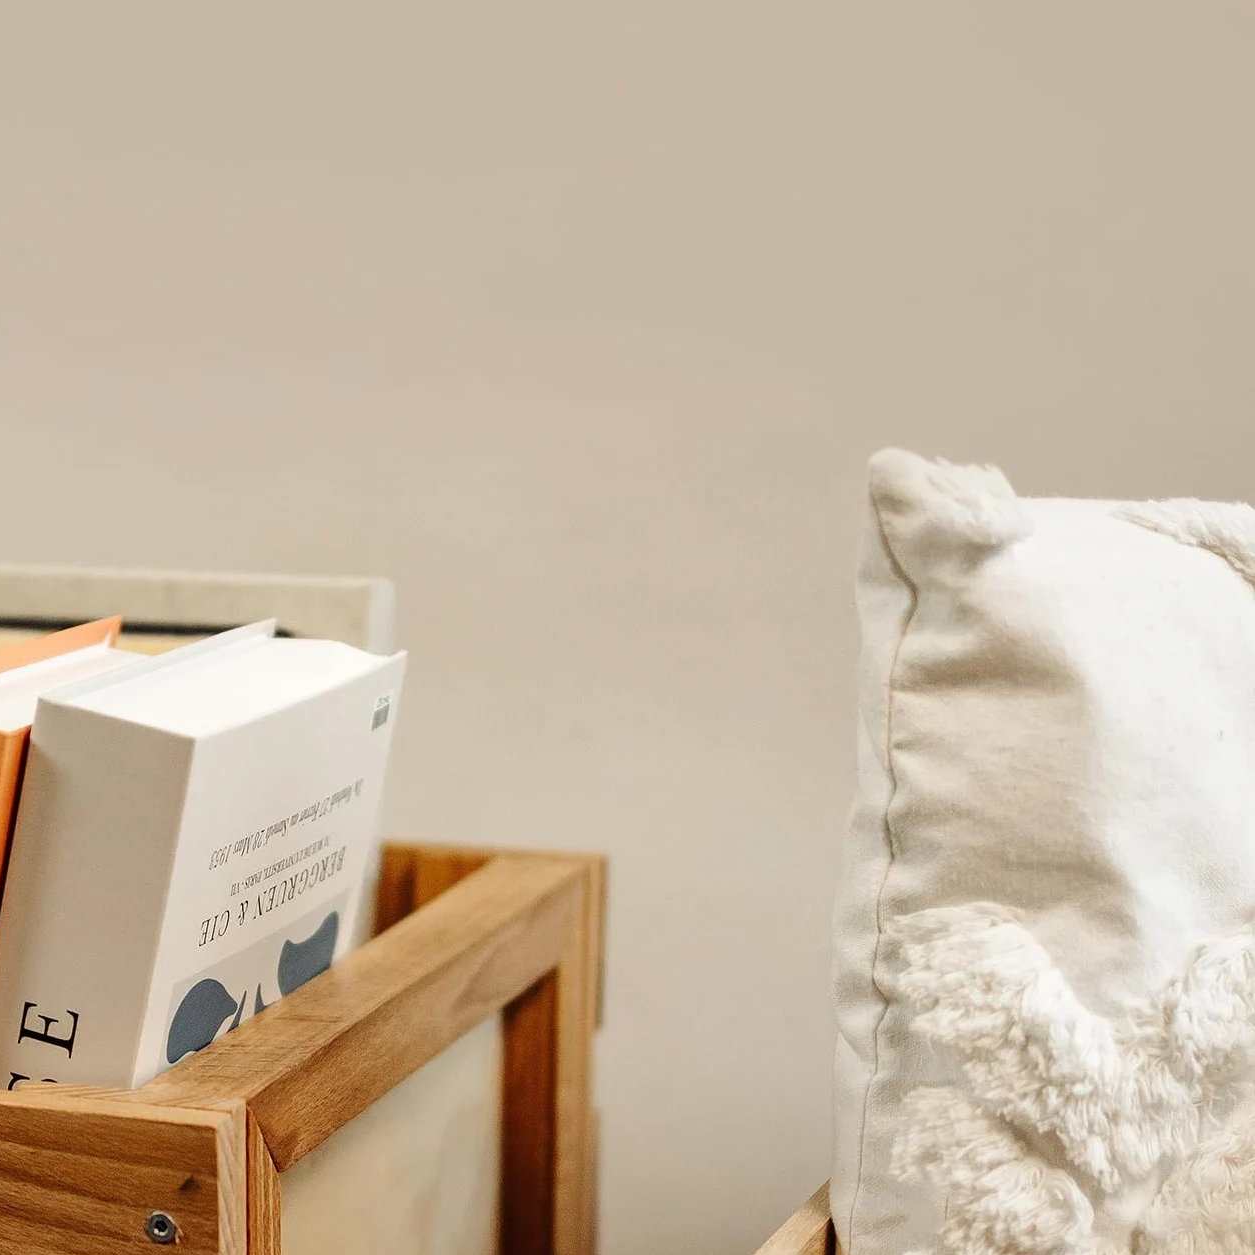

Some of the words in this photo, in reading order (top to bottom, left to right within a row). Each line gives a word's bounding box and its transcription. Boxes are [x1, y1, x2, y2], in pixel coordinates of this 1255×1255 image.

[253, 845, 347, 920] BERGGRUEN
[198, 910, 230, 947] CIE
[237, 900, 249, 926] &
